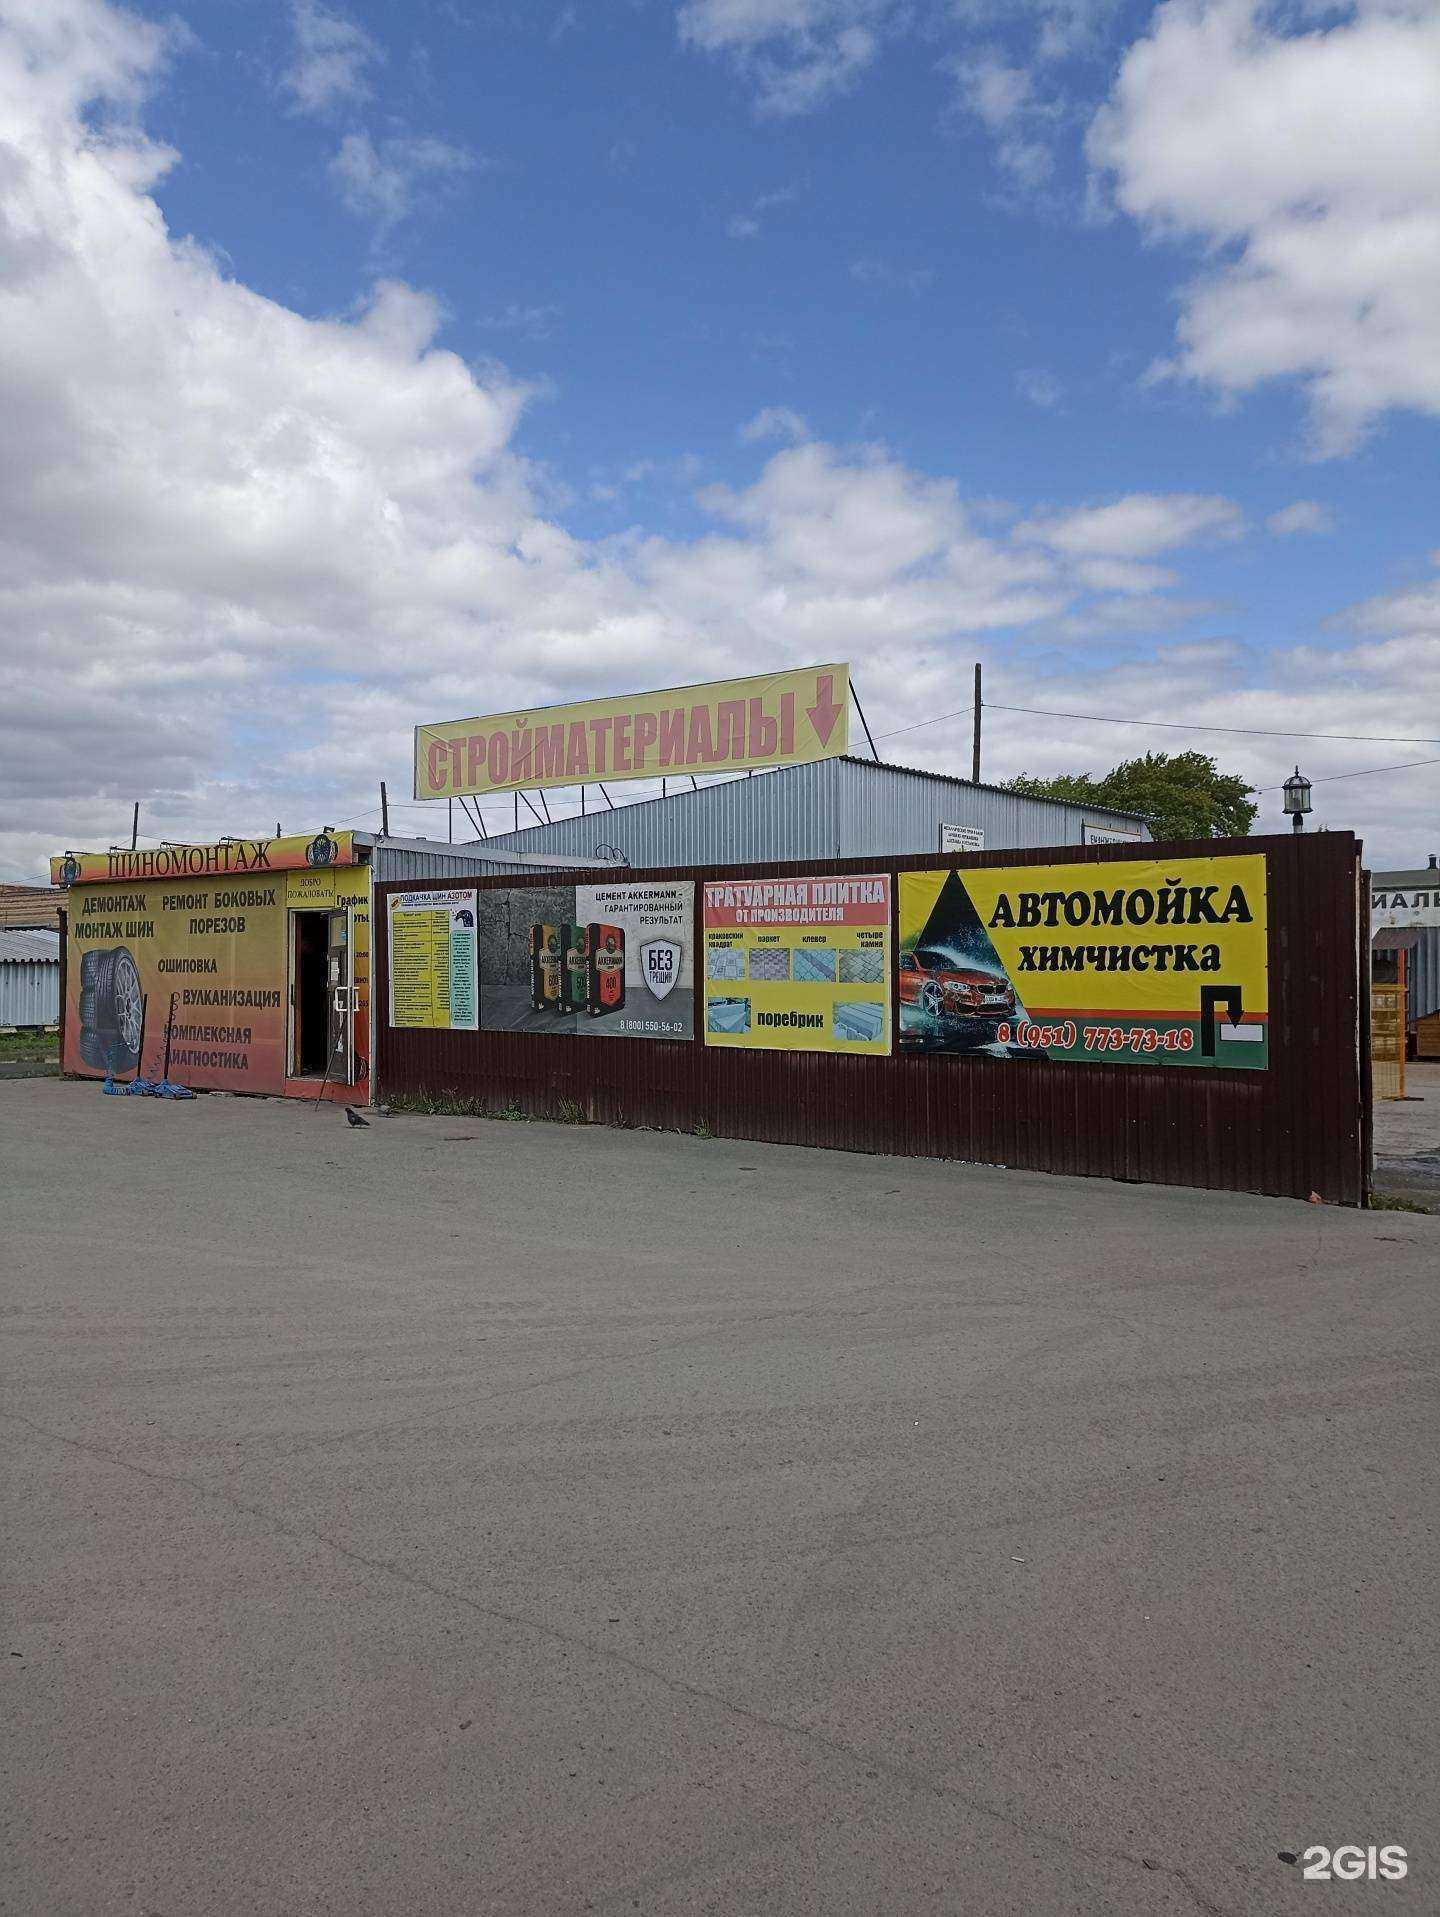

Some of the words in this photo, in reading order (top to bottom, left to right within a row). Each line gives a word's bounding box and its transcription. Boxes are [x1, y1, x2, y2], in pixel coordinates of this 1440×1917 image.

[428, 692, 795, 790] СТРОЙМАТЕРИАЛЫ
[106, 841, 272, 878] ШИНОМОНТАЖ
[300, 878, 322, 887] ДОБРО
[162, 893, 208, 911] РЕМОНТ
[214, 889, 276, 909] БОКОВЫХ
[336, 894, 369, 907] График
[447, 891, 472, 900] АЗОТОМ
[596, 891, 626, 901] ЦЕМЕНТ
[627, 890, 677, 900] AKKERMANN
[706, 883, 808, 908] ТРАТУАРНАЯ
[812, 881, 885, 905] ПЛИТКА
[988, 877, 1253, 928] АВТОМОЙКА
[1372, 892, 1440, 909] ИАЛ
[82, 895, 147, 916] ДЕМОНТАЖ
[604, 901, 683, 913] ГАРАНТИРОВАННЫЙ
[640, 916, 683, 925] РЕЗУЛЬТАТ
[735, 909, 749, 923] ОТ
[751, 907, 844, 923] ПРОИЗВОДИТЕЛЯ
[75, 922, 123, 939] МОНТАЖ
[126, 921, 154, 938] ШИН
[190, 917, 246, 934] ПОРЕЗОВ
[856, 931, 884, 939] четыре
[158, 958, 218, 973] ОШИПОВКА
[649, 949, 673, 970] БЕЗ
[1017, 944, 1221, 972] химчистка
[649, 971, 673, 983] ТРЕЩИН
[182, 989, 281, 1010] ВУЛКАНИЗАЦИЯ
[620, 1020, 625, 1030] 8
[626, 1019, 644, 1030] (800)
[757, 1011, 824, 1028] поребрик
[997, 1022, 1011, 1043] 8
[1016, 1020, 1077, 1049] (951)
[1083, 1026, 1194, 1053] 773-73-18
